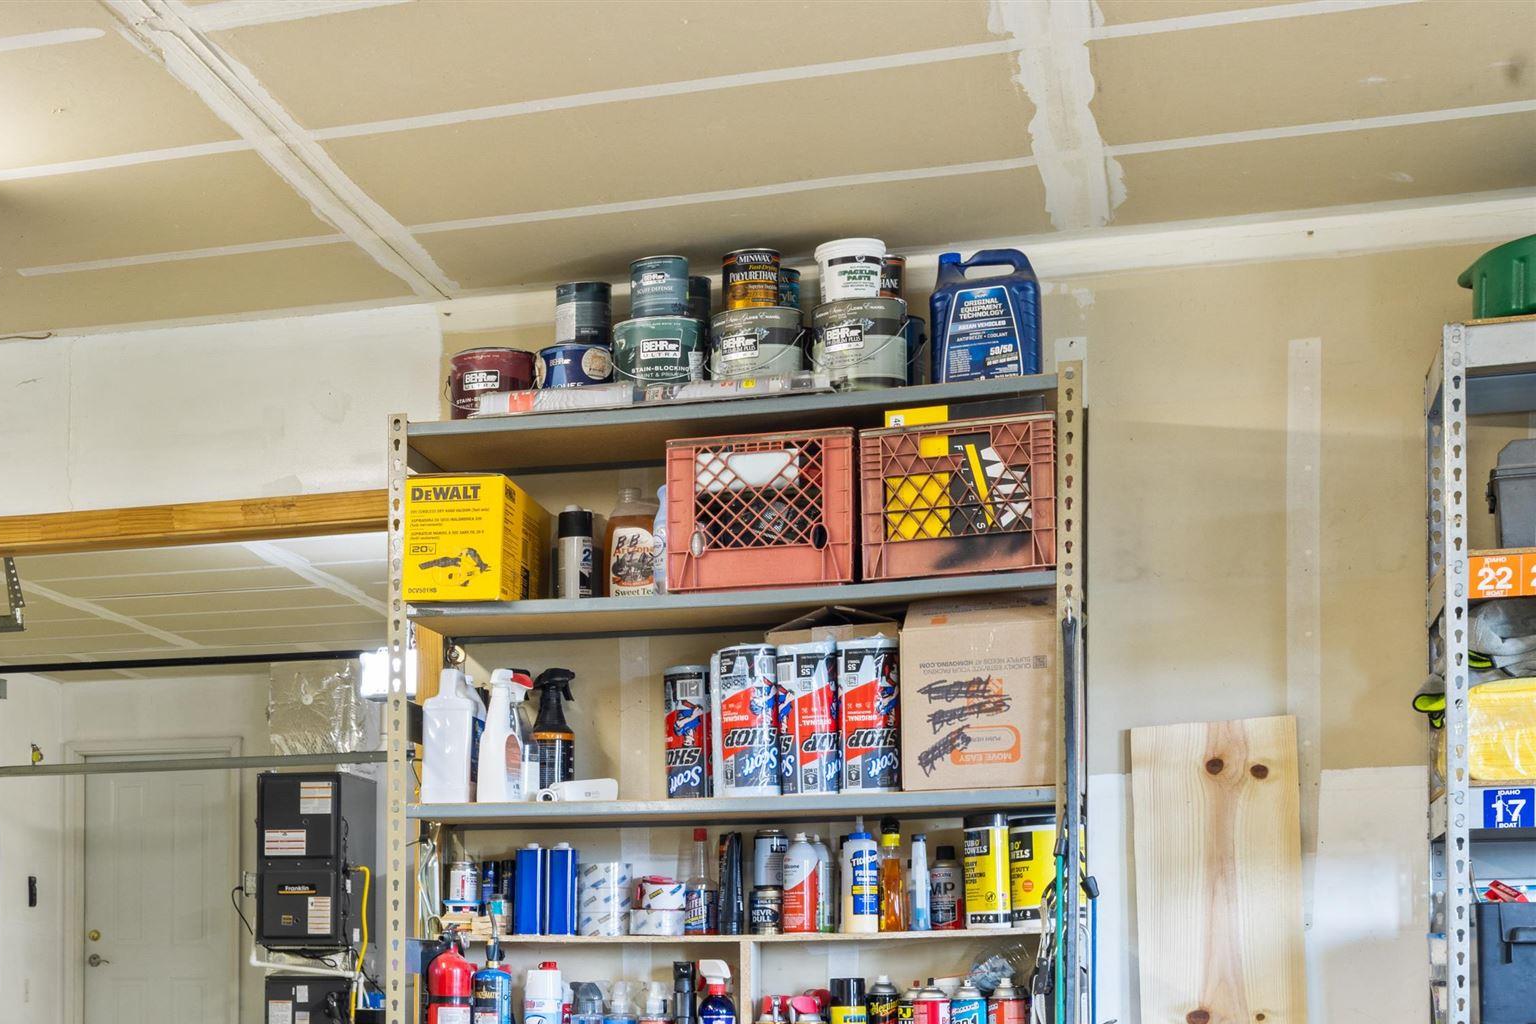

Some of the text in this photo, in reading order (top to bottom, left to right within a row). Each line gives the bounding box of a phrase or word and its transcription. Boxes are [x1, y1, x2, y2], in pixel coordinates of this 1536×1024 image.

[738, 254, 771, 263] MINWAX
[729, 271, 778, 282] POLYURETHANE
[964, 297, 999, 307] ORIGINAL
[960, 303, 1003, 313] EQUIPMENT
[959, 309, 1005, 320] TECHNOLOGY
[826, 327, 849, 340] BEHR
[643, 341, 666, 352] BEHR
[723, 336, 745, 348] BEHR
[989, 344, 1013, 355] 50/50
[631, 365, 689, 374] STAIN-BLOCKING
[465, 371, 488, 383] BEHR
[456, 396, 483, 405] STAIN-B
[629, 533, 640, 547] B
[1484, 556, 1507, 564] IDAHO
[1477, 567, 1514, 590] 22
[614, 589, 640, 597] Sweet
[801, 668, 810, 676] 55
[724, 727, 777, 749] SHOP
[847, 728, 897, 749] SHOP
[665, 747, 701, 767] SHO
[743, 747, 778, 776] Scott
[959, 752, 1013, 762] MOVE EASY
[868, 748, 899, 778] Scott
[669, 765, 703, 793] Scott
[1491, 799, 1527, 822] 17
[869, 1000, 898, 1016] Meguiar
[843, 1015, 866, 1023] rain
